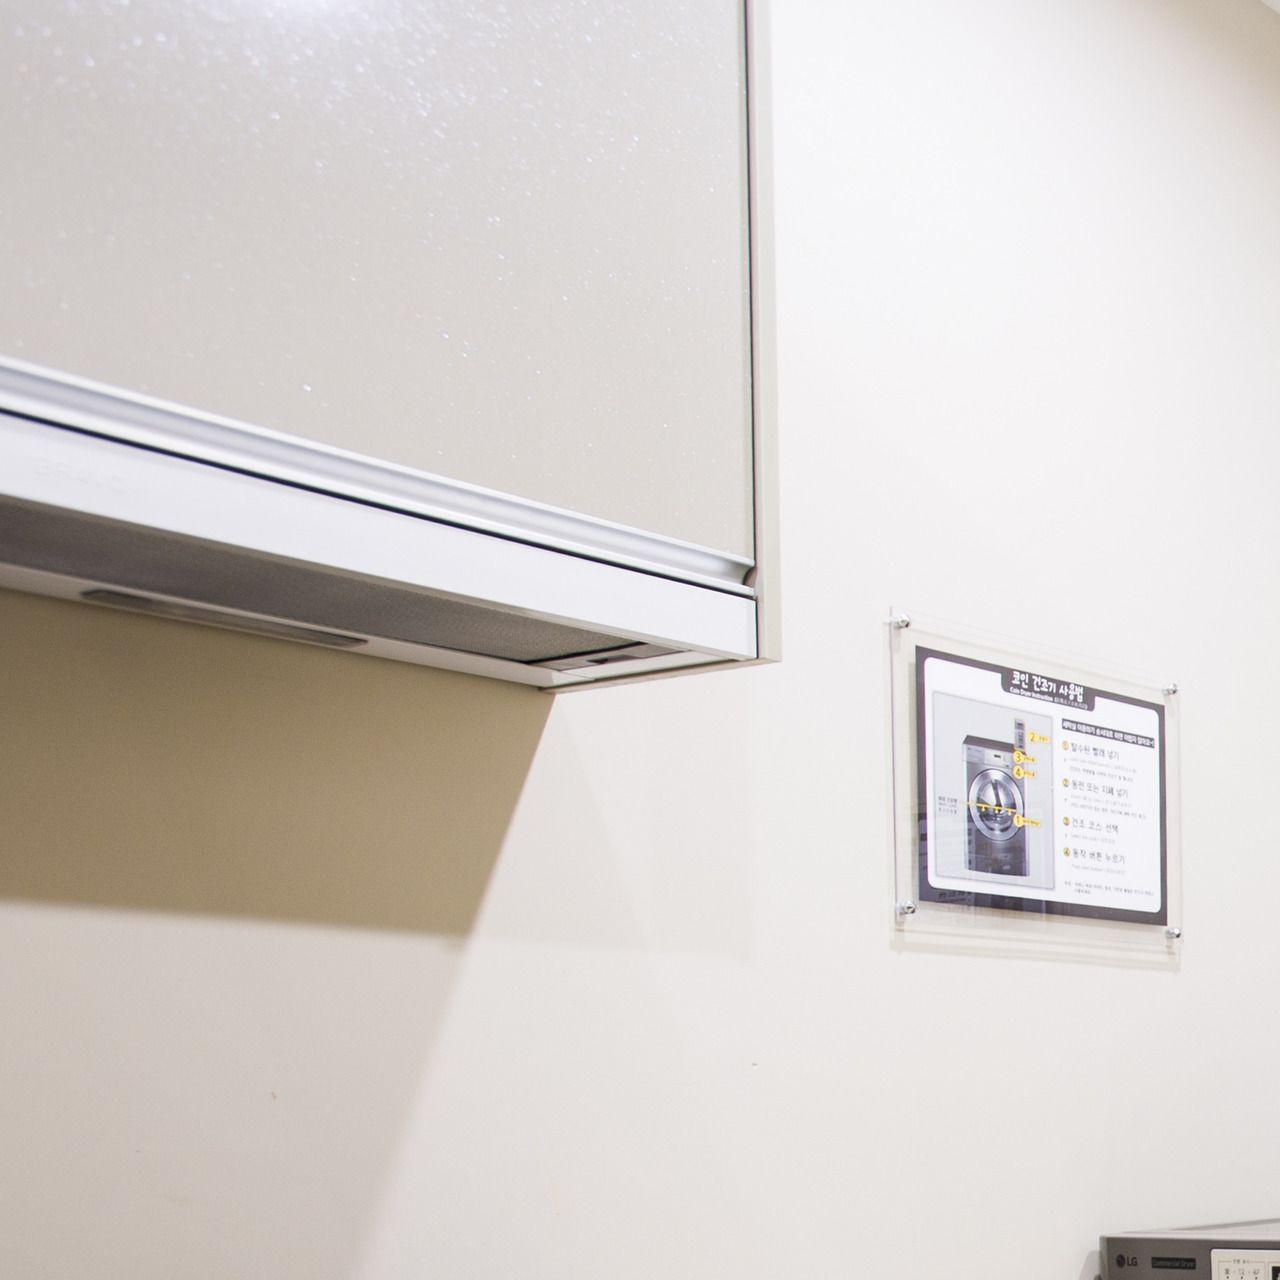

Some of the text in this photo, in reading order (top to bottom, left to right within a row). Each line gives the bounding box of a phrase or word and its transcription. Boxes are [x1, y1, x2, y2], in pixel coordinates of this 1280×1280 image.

[1012, 671, 1084, 702] 코인 건조기 사용법
[1127, 1257, 1138, 1267] LG
